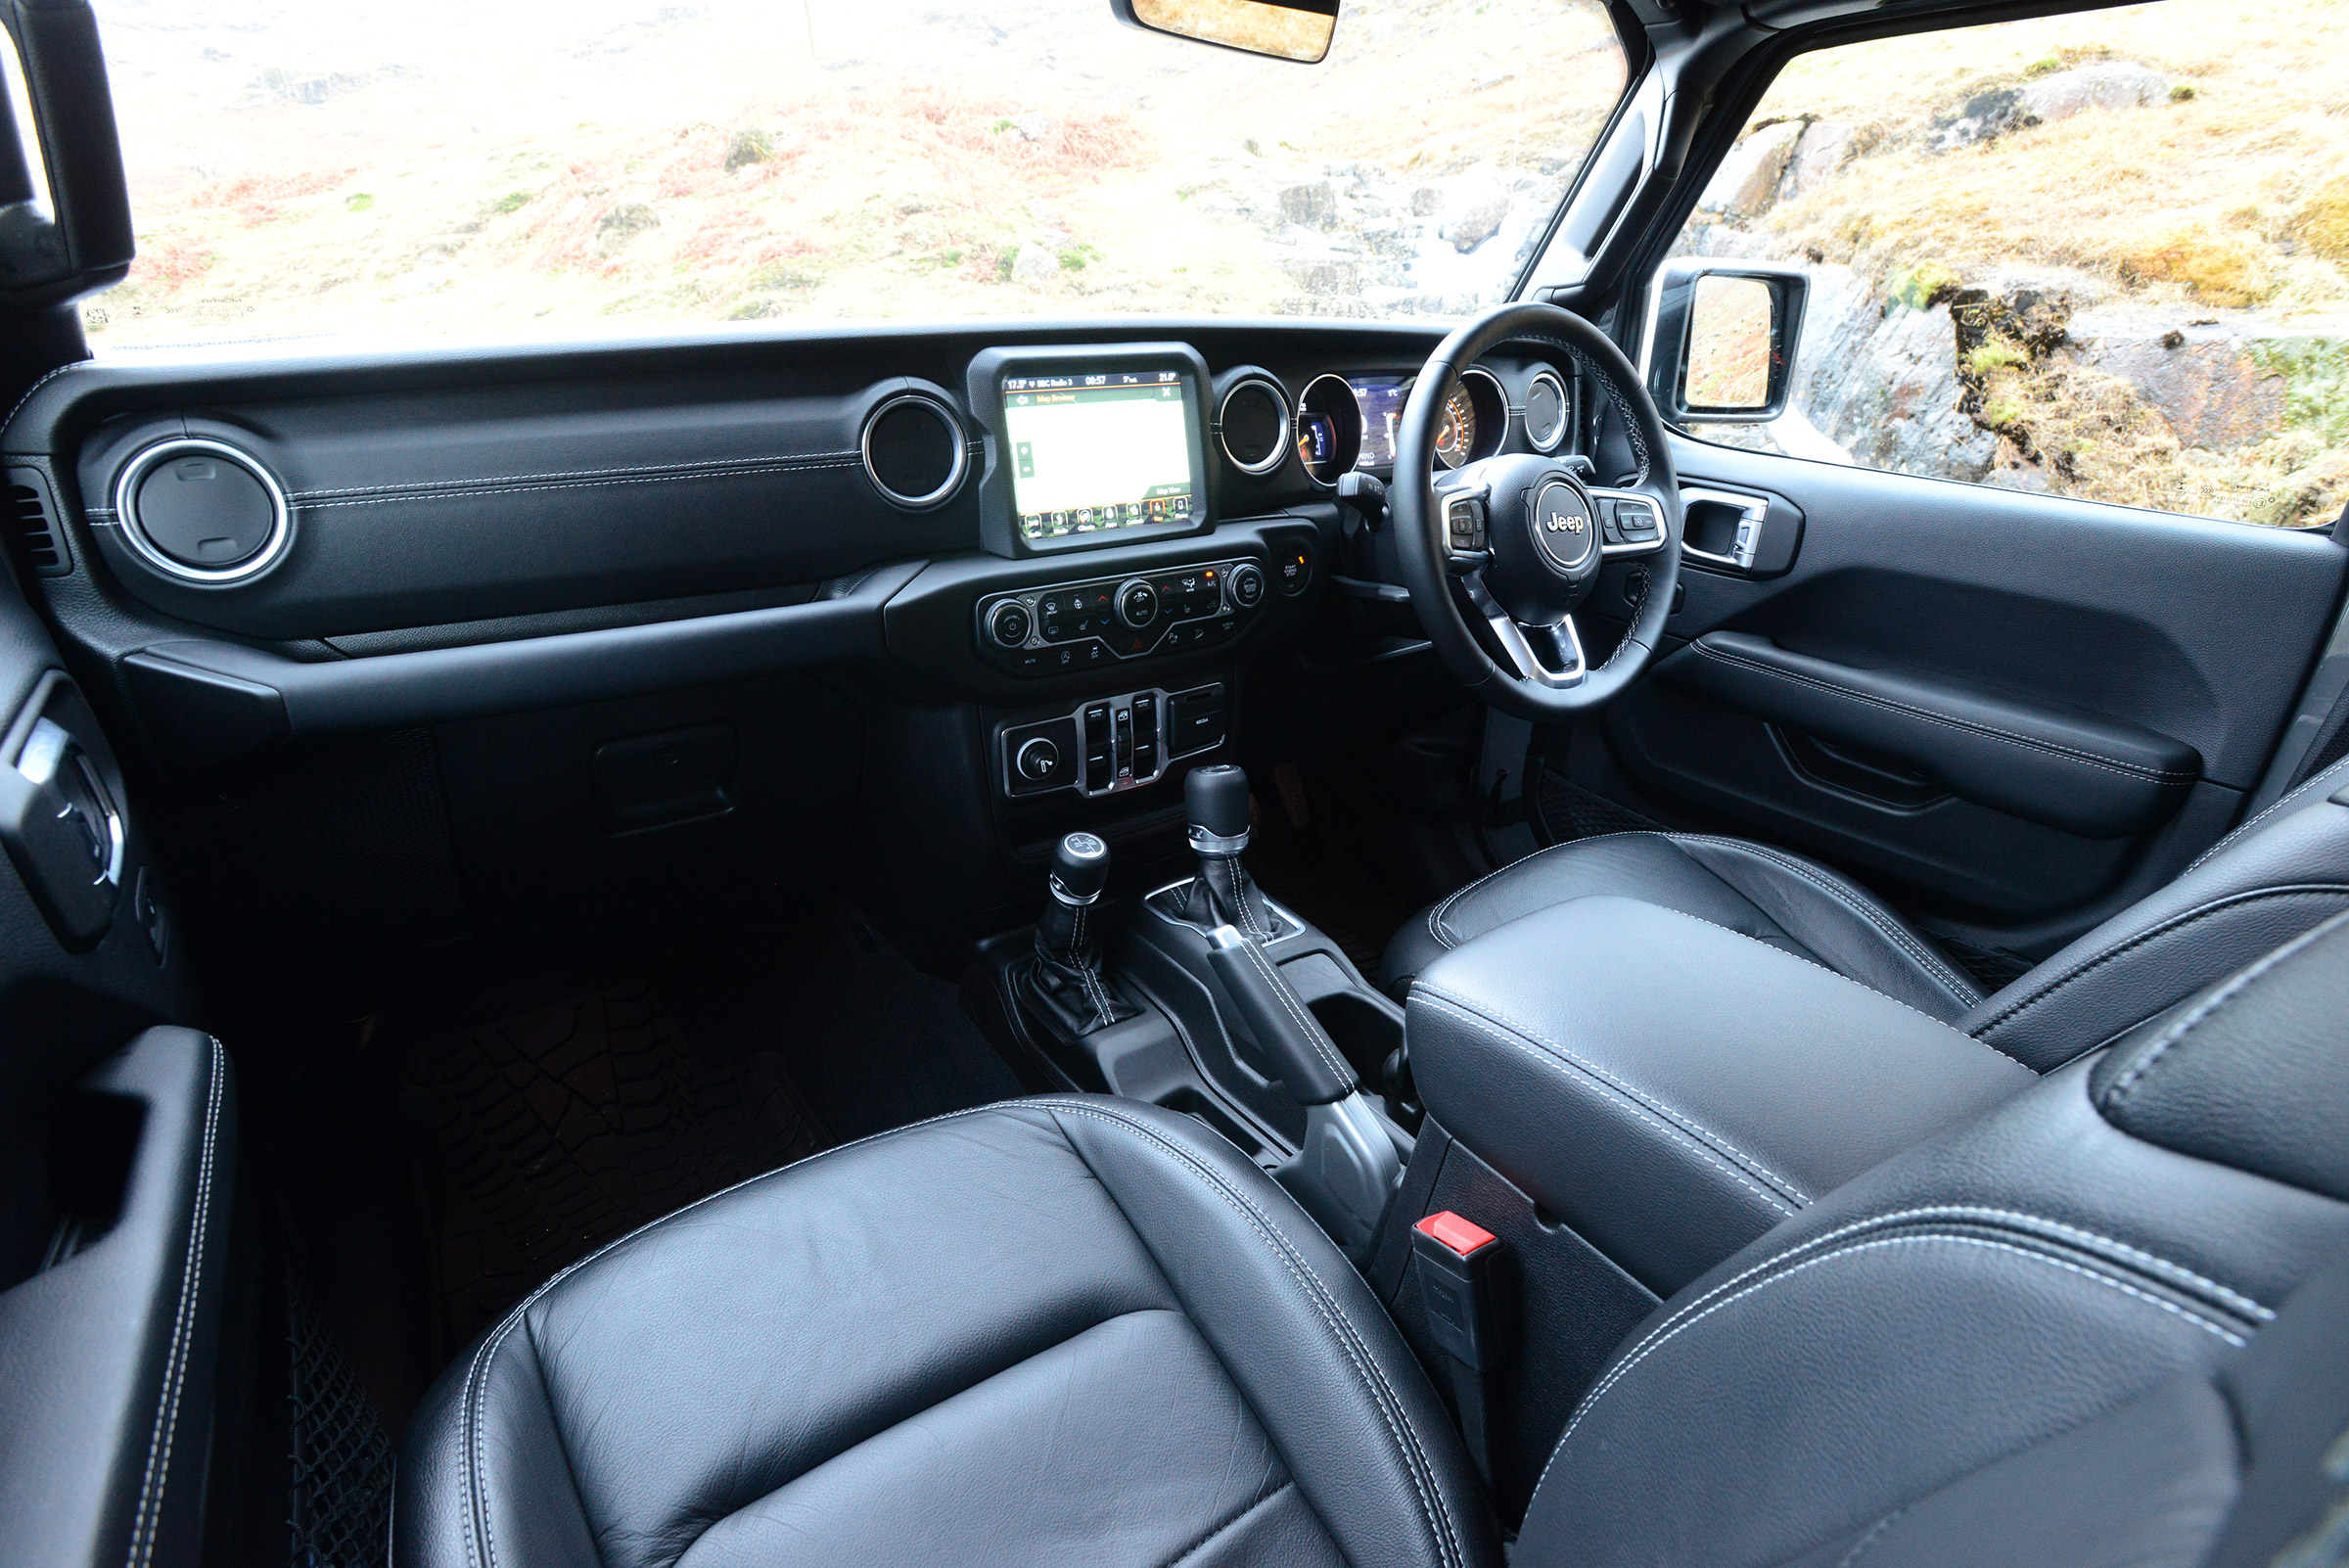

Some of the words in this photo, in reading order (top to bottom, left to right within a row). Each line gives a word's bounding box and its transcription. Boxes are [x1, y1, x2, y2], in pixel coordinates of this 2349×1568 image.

[1036, 379, 1050, 388] BBC
[1050, 378, 1067, 387] Radio
[1051, 393, 1076, 402] Browser
[1545, 511, 1585, 535] Jeep
[1195, 716, 1210, 725] MEDIA
